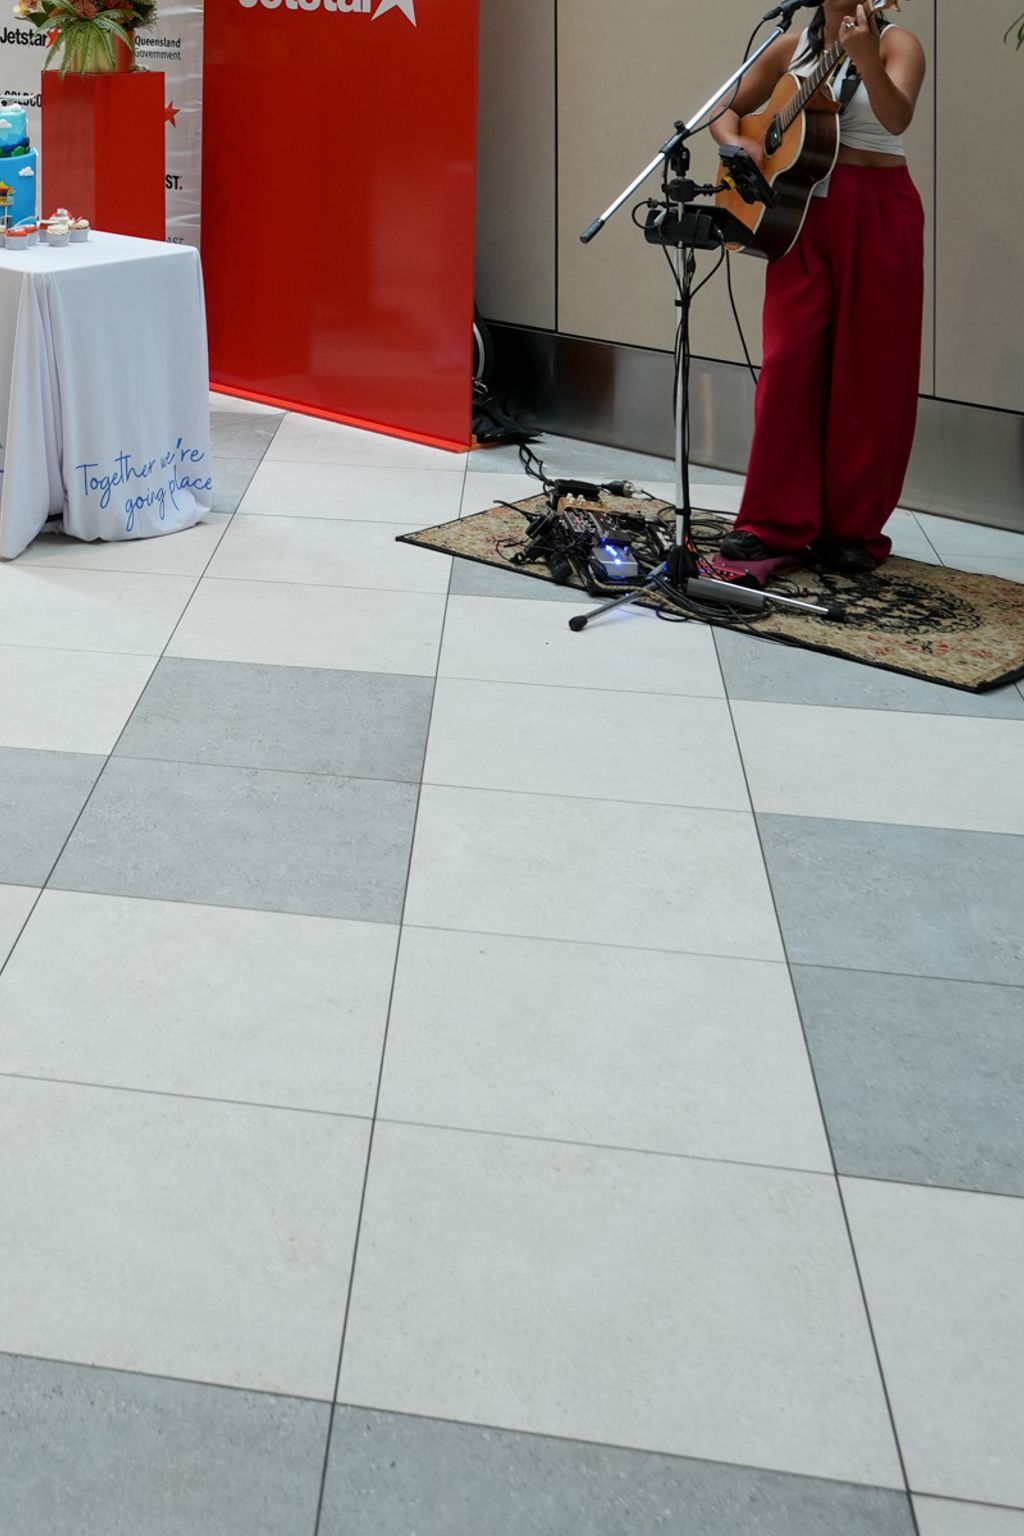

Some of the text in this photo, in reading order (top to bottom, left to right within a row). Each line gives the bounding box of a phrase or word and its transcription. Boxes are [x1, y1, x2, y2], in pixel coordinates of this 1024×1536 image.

[0, 27, 48, 47] Jetstar
[135, 35, 180, 48] Queensland
[76, 450, 156, 509] Together
[126, 488, 166, 532] going
